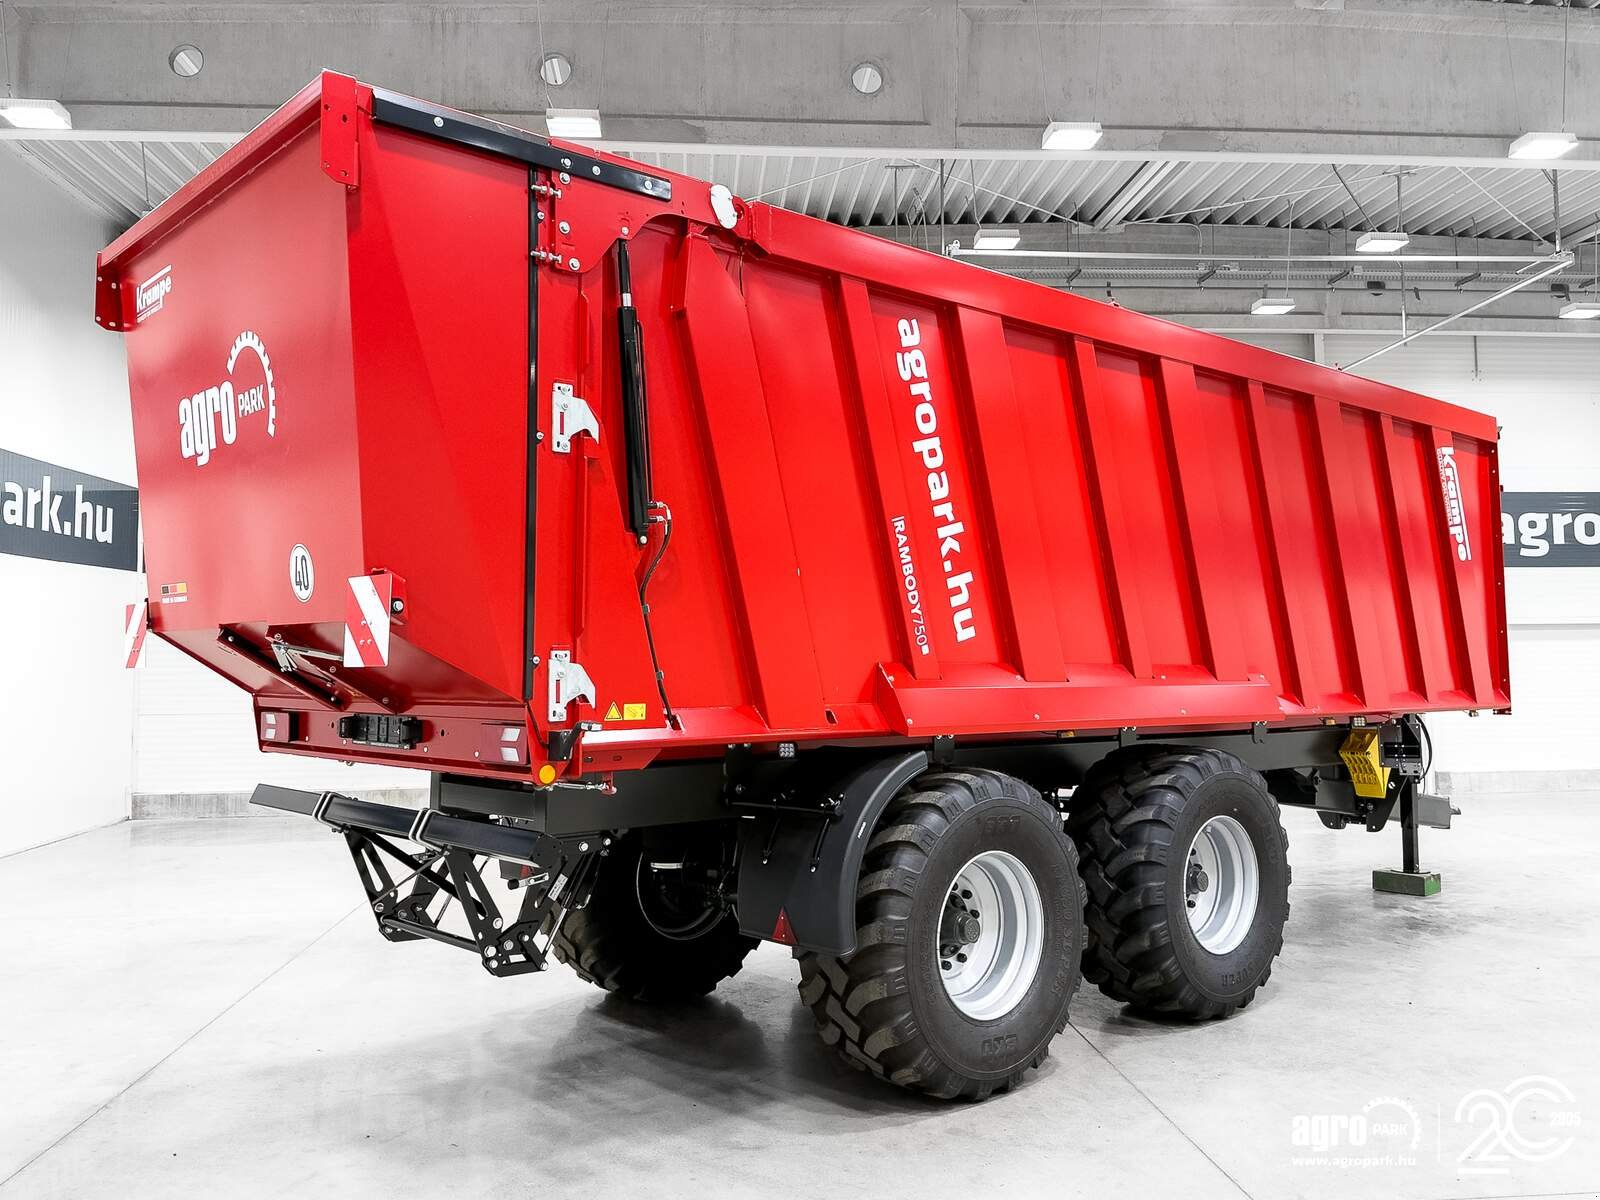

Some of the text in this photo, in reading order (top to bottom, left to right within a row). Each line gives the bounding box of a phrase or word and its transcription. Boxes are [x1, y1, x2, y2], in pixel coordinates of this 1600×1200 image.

[136, 265, 172, 313] Krampe
[178, 381, 266, 467] agro PARK
[896, 318, 976, 643] agropark.hu
[1441, 446, 1472, 562] Krampe
[294, 554, 310, 592] 40
